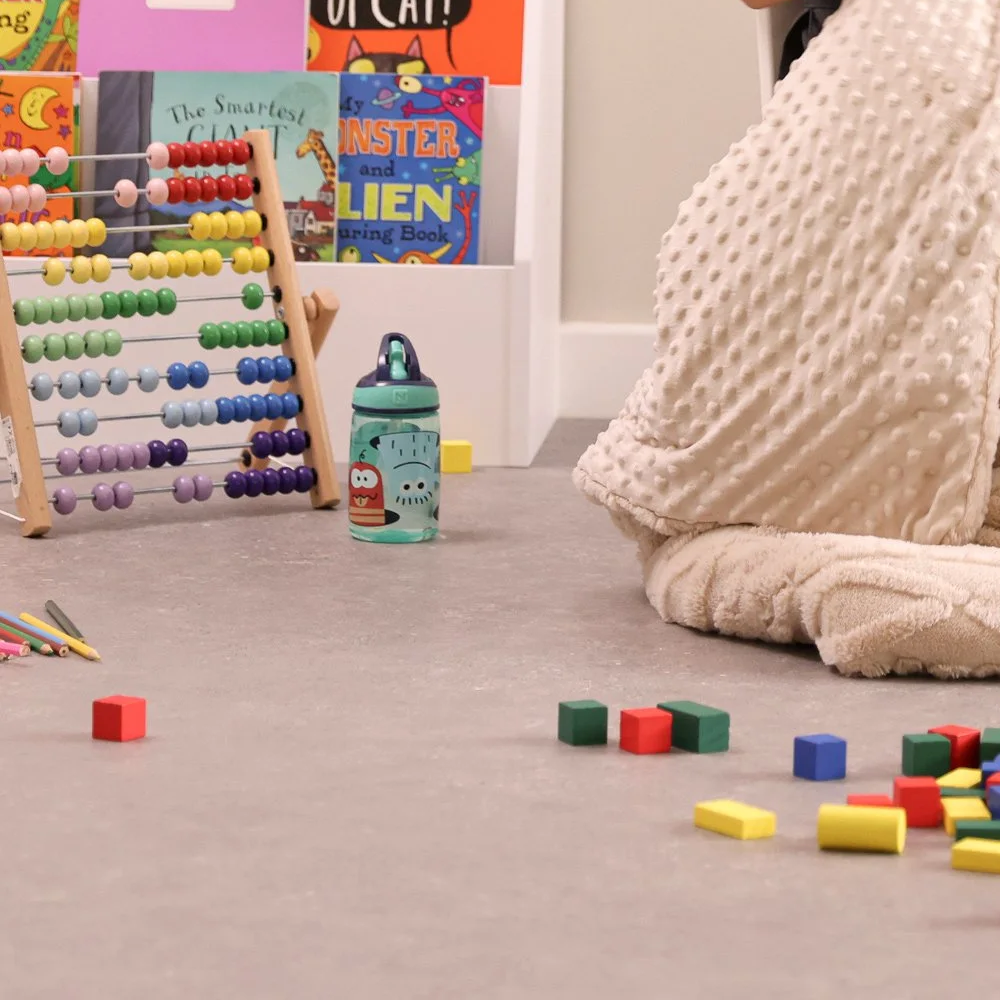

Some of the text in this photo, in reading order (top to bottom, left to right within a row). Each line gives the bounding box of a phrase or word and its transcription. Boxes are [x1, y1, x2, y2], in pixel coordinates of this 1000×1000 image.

[166, 93, 306, 127] The Smartest
[359, 160, 395, 177] and
[400, 224, 450, 243] Book
